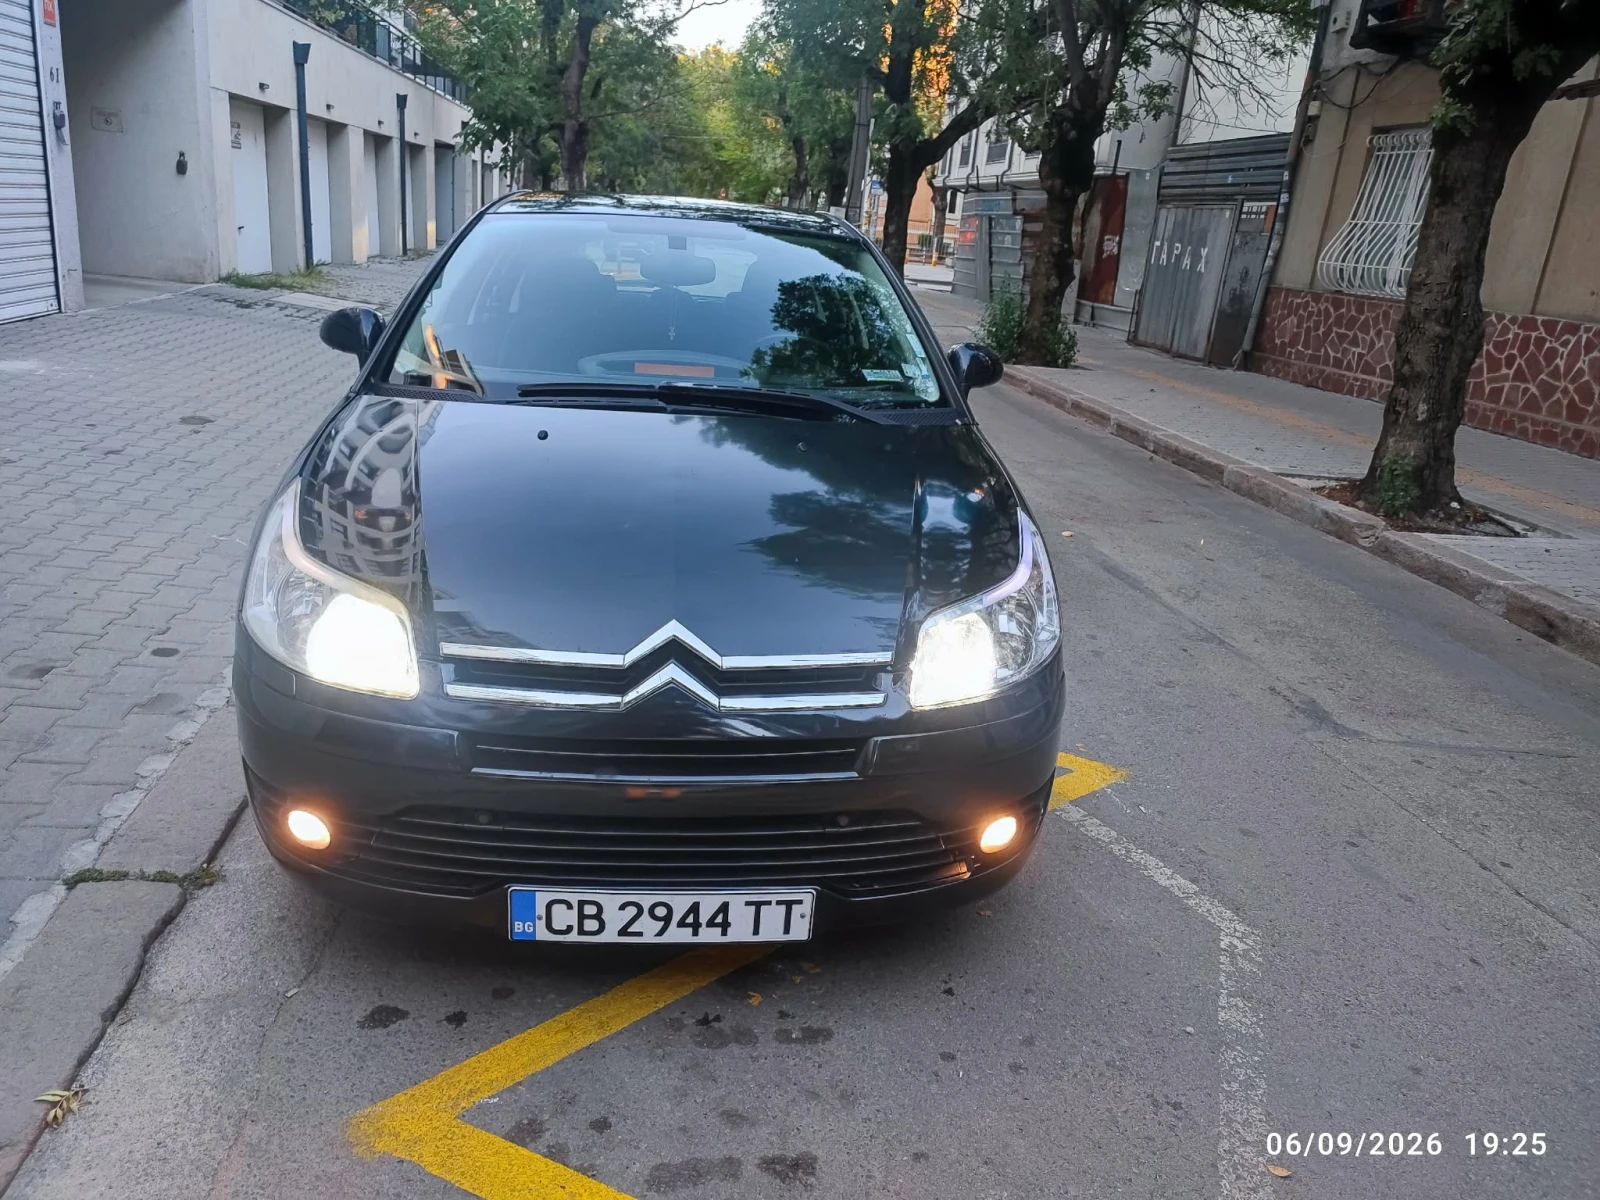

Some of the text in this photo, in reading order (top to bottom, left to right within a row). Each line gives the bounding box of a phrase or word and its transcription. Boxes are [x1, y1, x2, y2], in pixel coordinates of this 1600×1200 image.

[50, 66, 60, 83] 61
[545, 898, 803, 937] CB 2944 TT
[514, 921, 534, 933] BG
